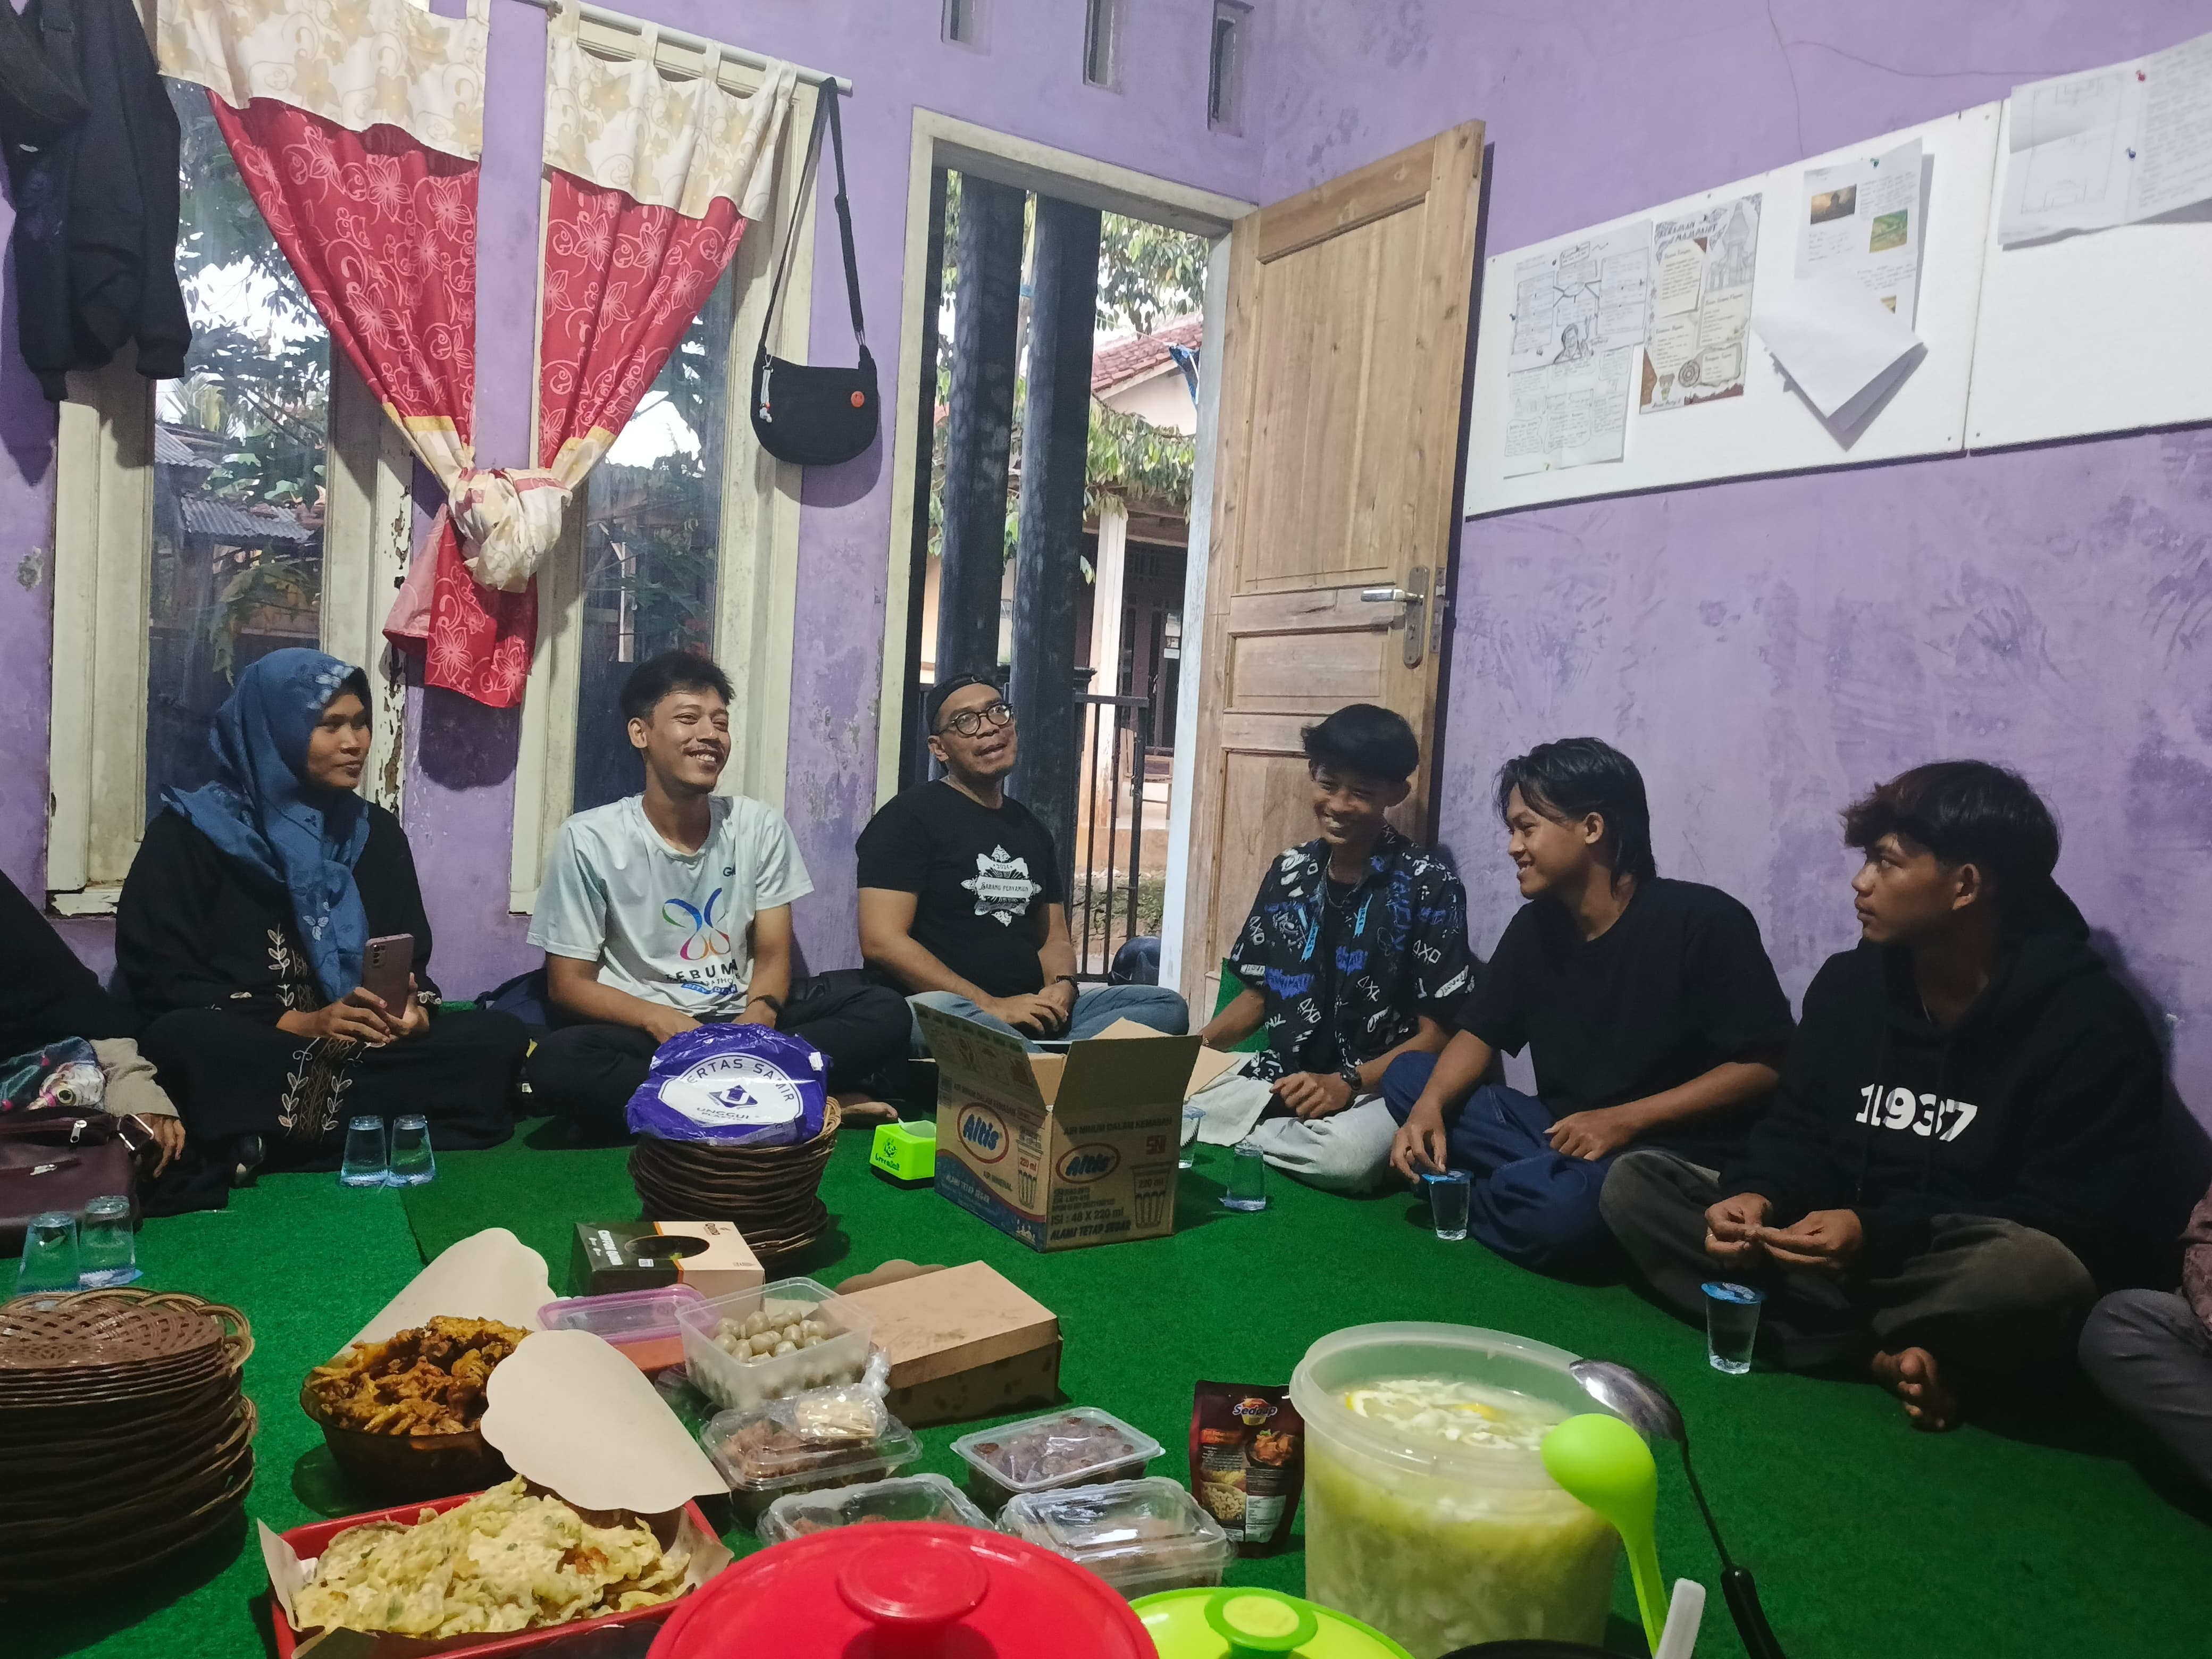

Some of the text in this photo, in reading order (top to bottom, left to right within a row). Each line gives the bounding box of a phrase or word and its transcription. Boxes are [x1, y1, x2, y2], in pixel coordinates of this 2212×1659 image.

[687, 1059, 743, 1084] ERTAS
[1855, 1083, 1978, 1142] 1937
[1064, 1117, 1172, 1136] AIR MINUM DALAM KEMASAN
[1051, 1215, 1062, 1226] ISI
[1071, 1212, 1083, 1222] 48
[1094, 1208, 1111, 1220] 220
[1112, 1207, 1124, 1218] ml
[1051, 1220, 1132, 1241] ALAMI TETAP SEGAR
